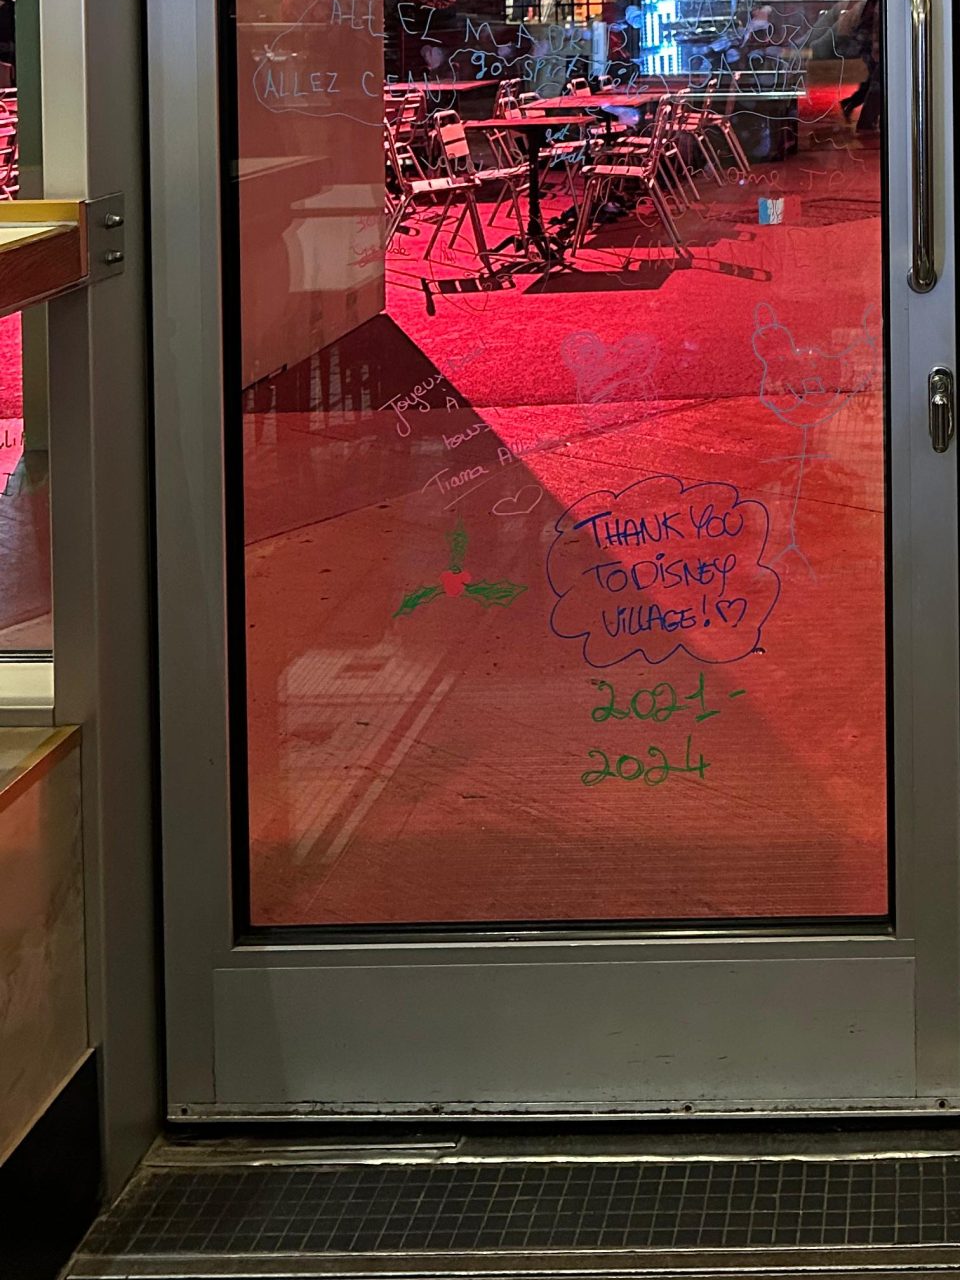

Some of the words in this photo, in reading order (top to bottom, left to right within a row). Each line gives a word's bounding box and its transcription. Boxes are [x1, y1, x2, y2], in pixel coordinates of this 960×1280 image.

[264, 73, 340, 98] ALLEZ
[573, 511, 684, 550] THANK
[689, 504, 744, 540] YOU
[591, 672, 720, 722] 2021
[580, 735, 712, 786] 2024
